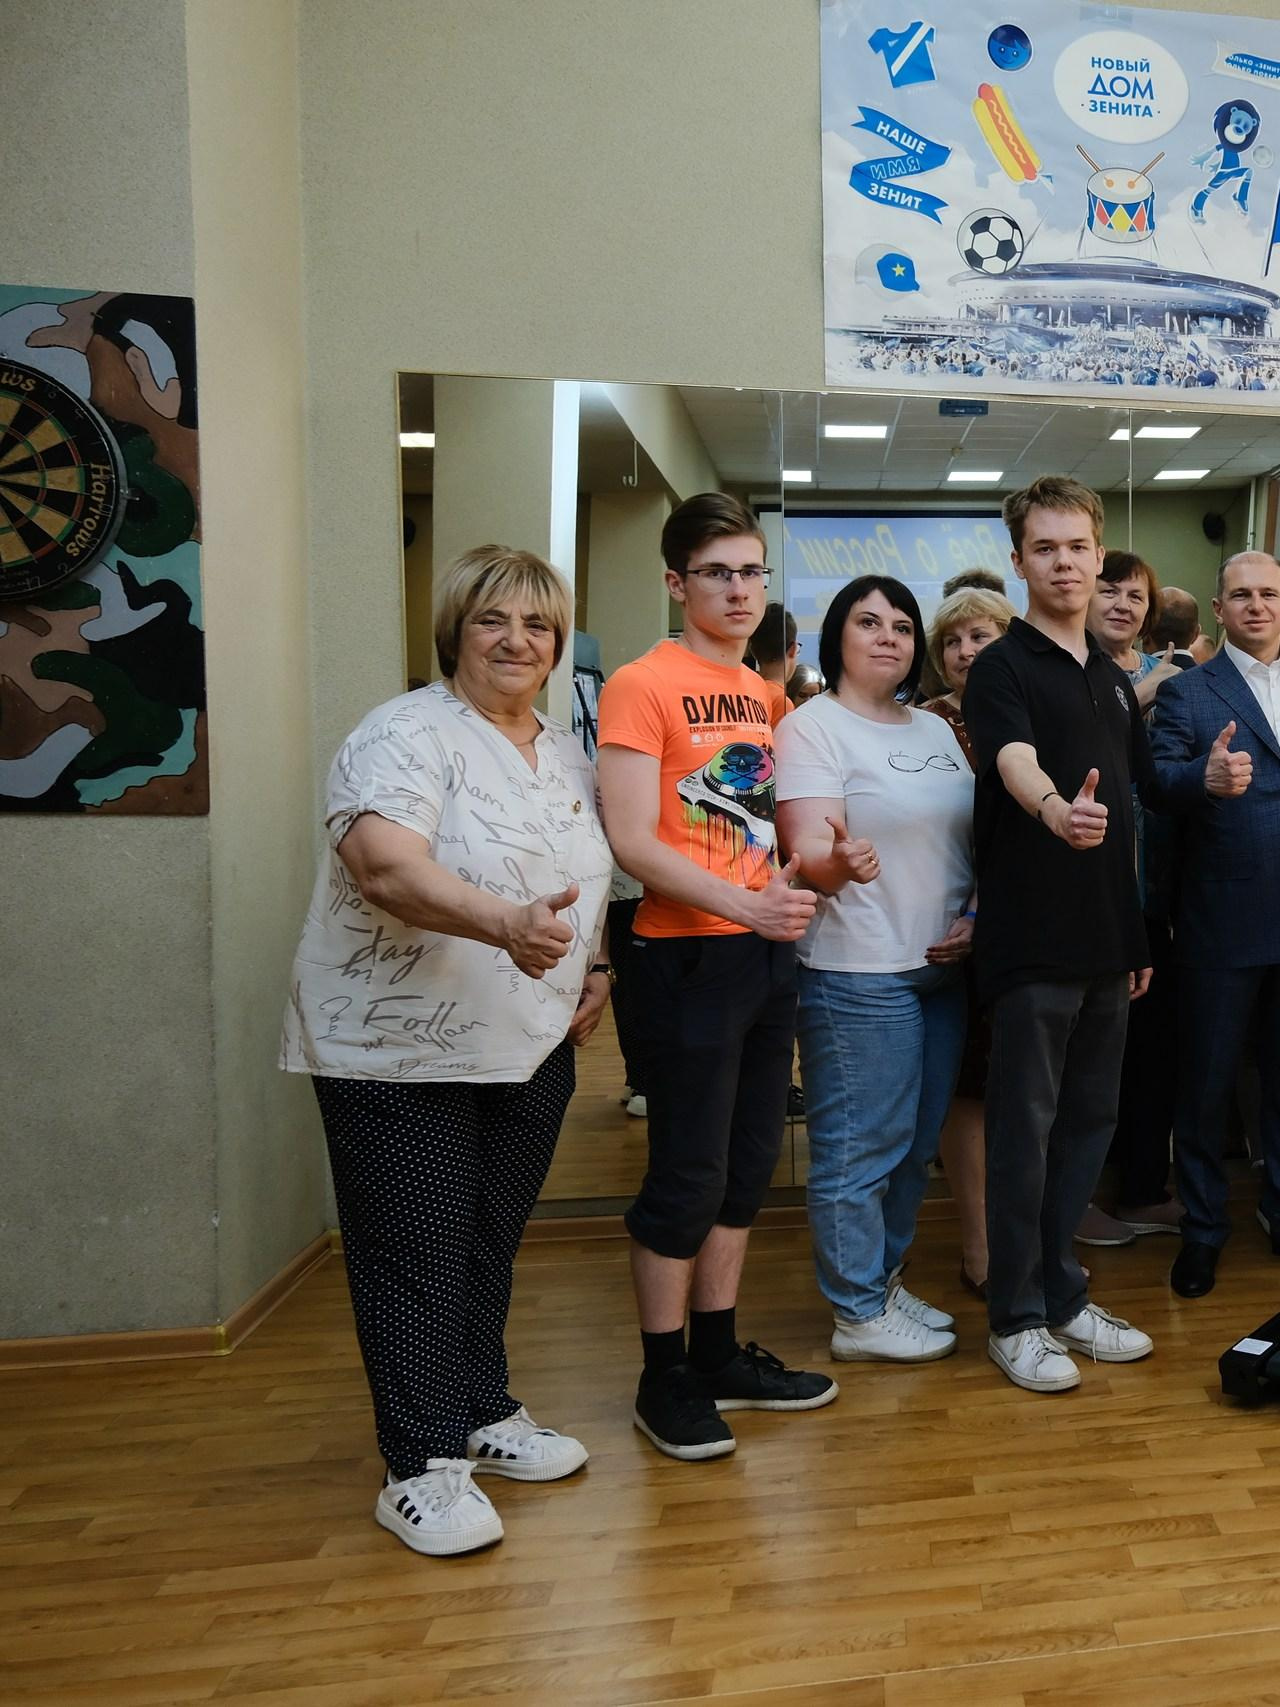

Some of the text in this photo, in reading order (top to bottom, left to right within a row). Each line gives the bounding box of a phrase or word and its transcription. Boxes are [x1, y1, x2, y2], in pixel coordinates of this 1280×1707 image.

[1091, 56, 1150, 73] НОВЫЙ
[1087, 73, 1154, 101] ДОМ
[1088, 99, 1153, 118] ЗЕНИТА
[876, 120, 927, 154] НАШЕ
[870, 156, 921, 180] ИМЯ
[868, 182, 922, 209] ЗЕНИТ
[65, 463, 111, 557] Harrows
[682, 693, 769, 726] DYNATIO
